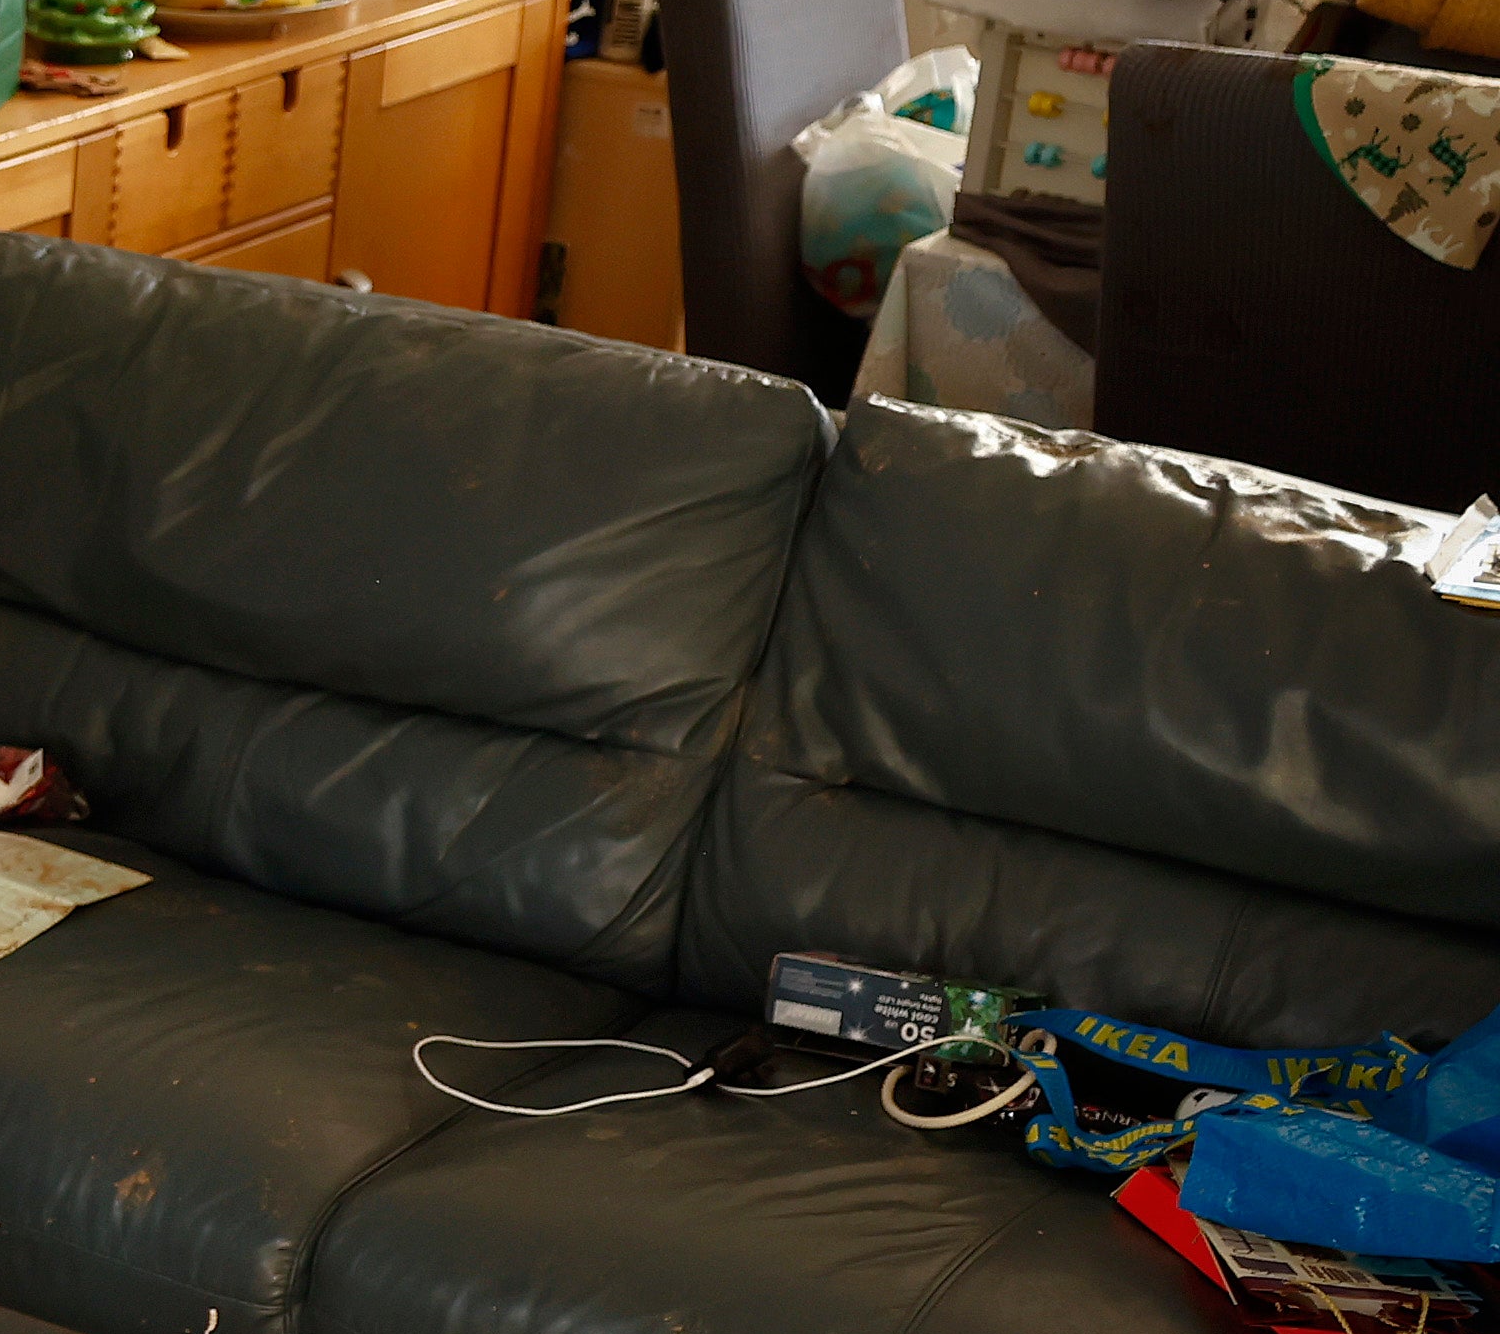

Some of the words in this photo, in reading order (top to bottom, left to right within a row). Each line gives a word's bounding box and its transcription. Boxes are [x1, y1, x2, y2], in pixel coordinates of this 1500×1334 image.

[873, 1003, 909, 1019] white
[911, 1011, 939, 1025] cool
[901, 1022, 937, 1044] 50
[1074, 1016, 1190, 1073] IKEA
